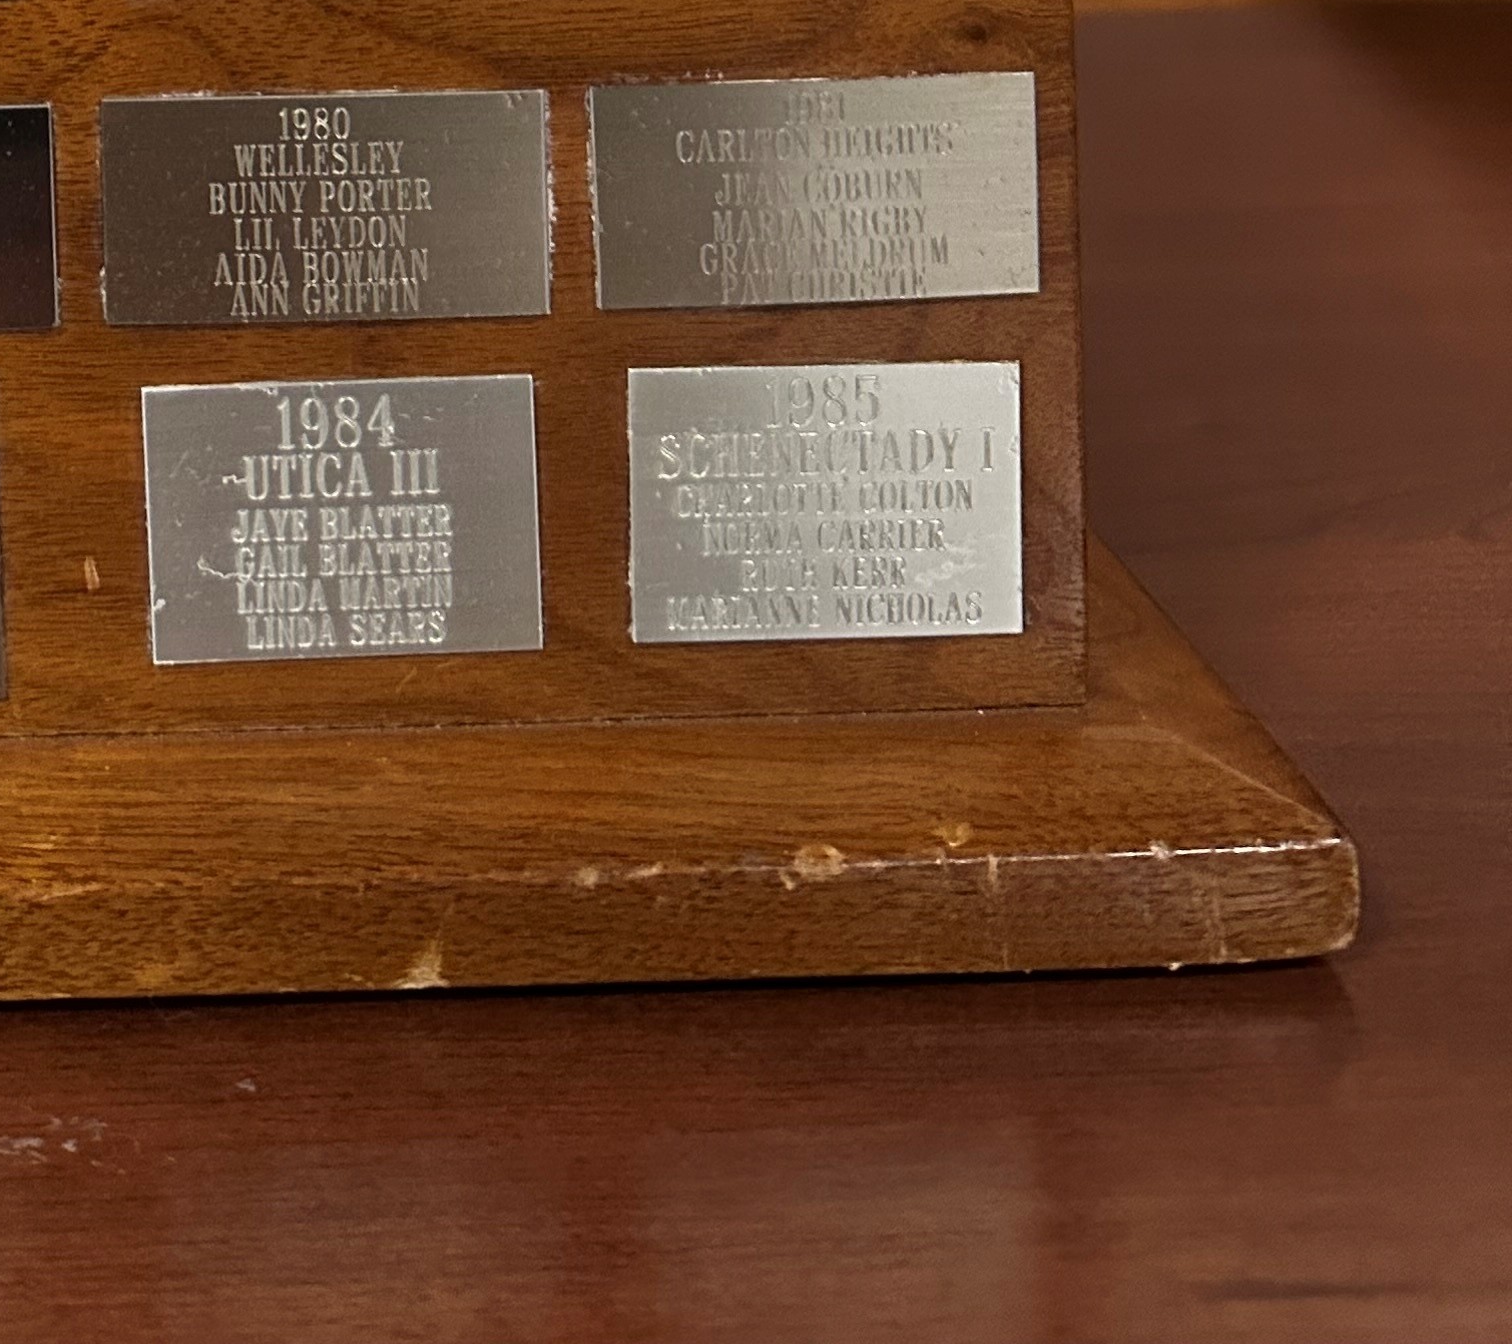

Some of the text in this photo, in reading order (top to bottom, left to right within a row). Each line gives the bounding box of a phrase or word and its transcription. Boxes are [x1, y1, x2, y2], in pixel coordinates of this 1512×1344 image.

[279, 108, 350, 140] 1980
[234, 141, 403, 177] WELLESLEY
[675, 126, 811, 164] CARLTON
[209, 178, 432, 214] BUNNY PORTER
[715, 167, 922, 206] JEAN COBURN
[233, 215, 407, 250] LIL LEYDON
[215, 248, 428, 286] AIDA BOWMAN
[230, 279, 420, 316] ANN GRIFFIN
[766, 374, 879, 430] 1985
[276, 394, 395, 451] 1984
[658, 426, 996, 480] SCHENECTADY I
[242, 449, 440, 500] UTICA III
[677, 479, 973, 517] CHARLOTTE COLTON
[232, 505, 453, 543] JAYE BLATTER
[703, 517, 946, 555] NORMA CARRIER
[236, 542, 452, 579] GAIL BLATTER
[742, 556, 906, 592] RUTH KERR
[237, 575, 453, 614] LINDA MARTIN
[668, 591, 983, 630] MARIANNE NICHOLAS
[246, 611, 446, 650] LINDA SEARS
